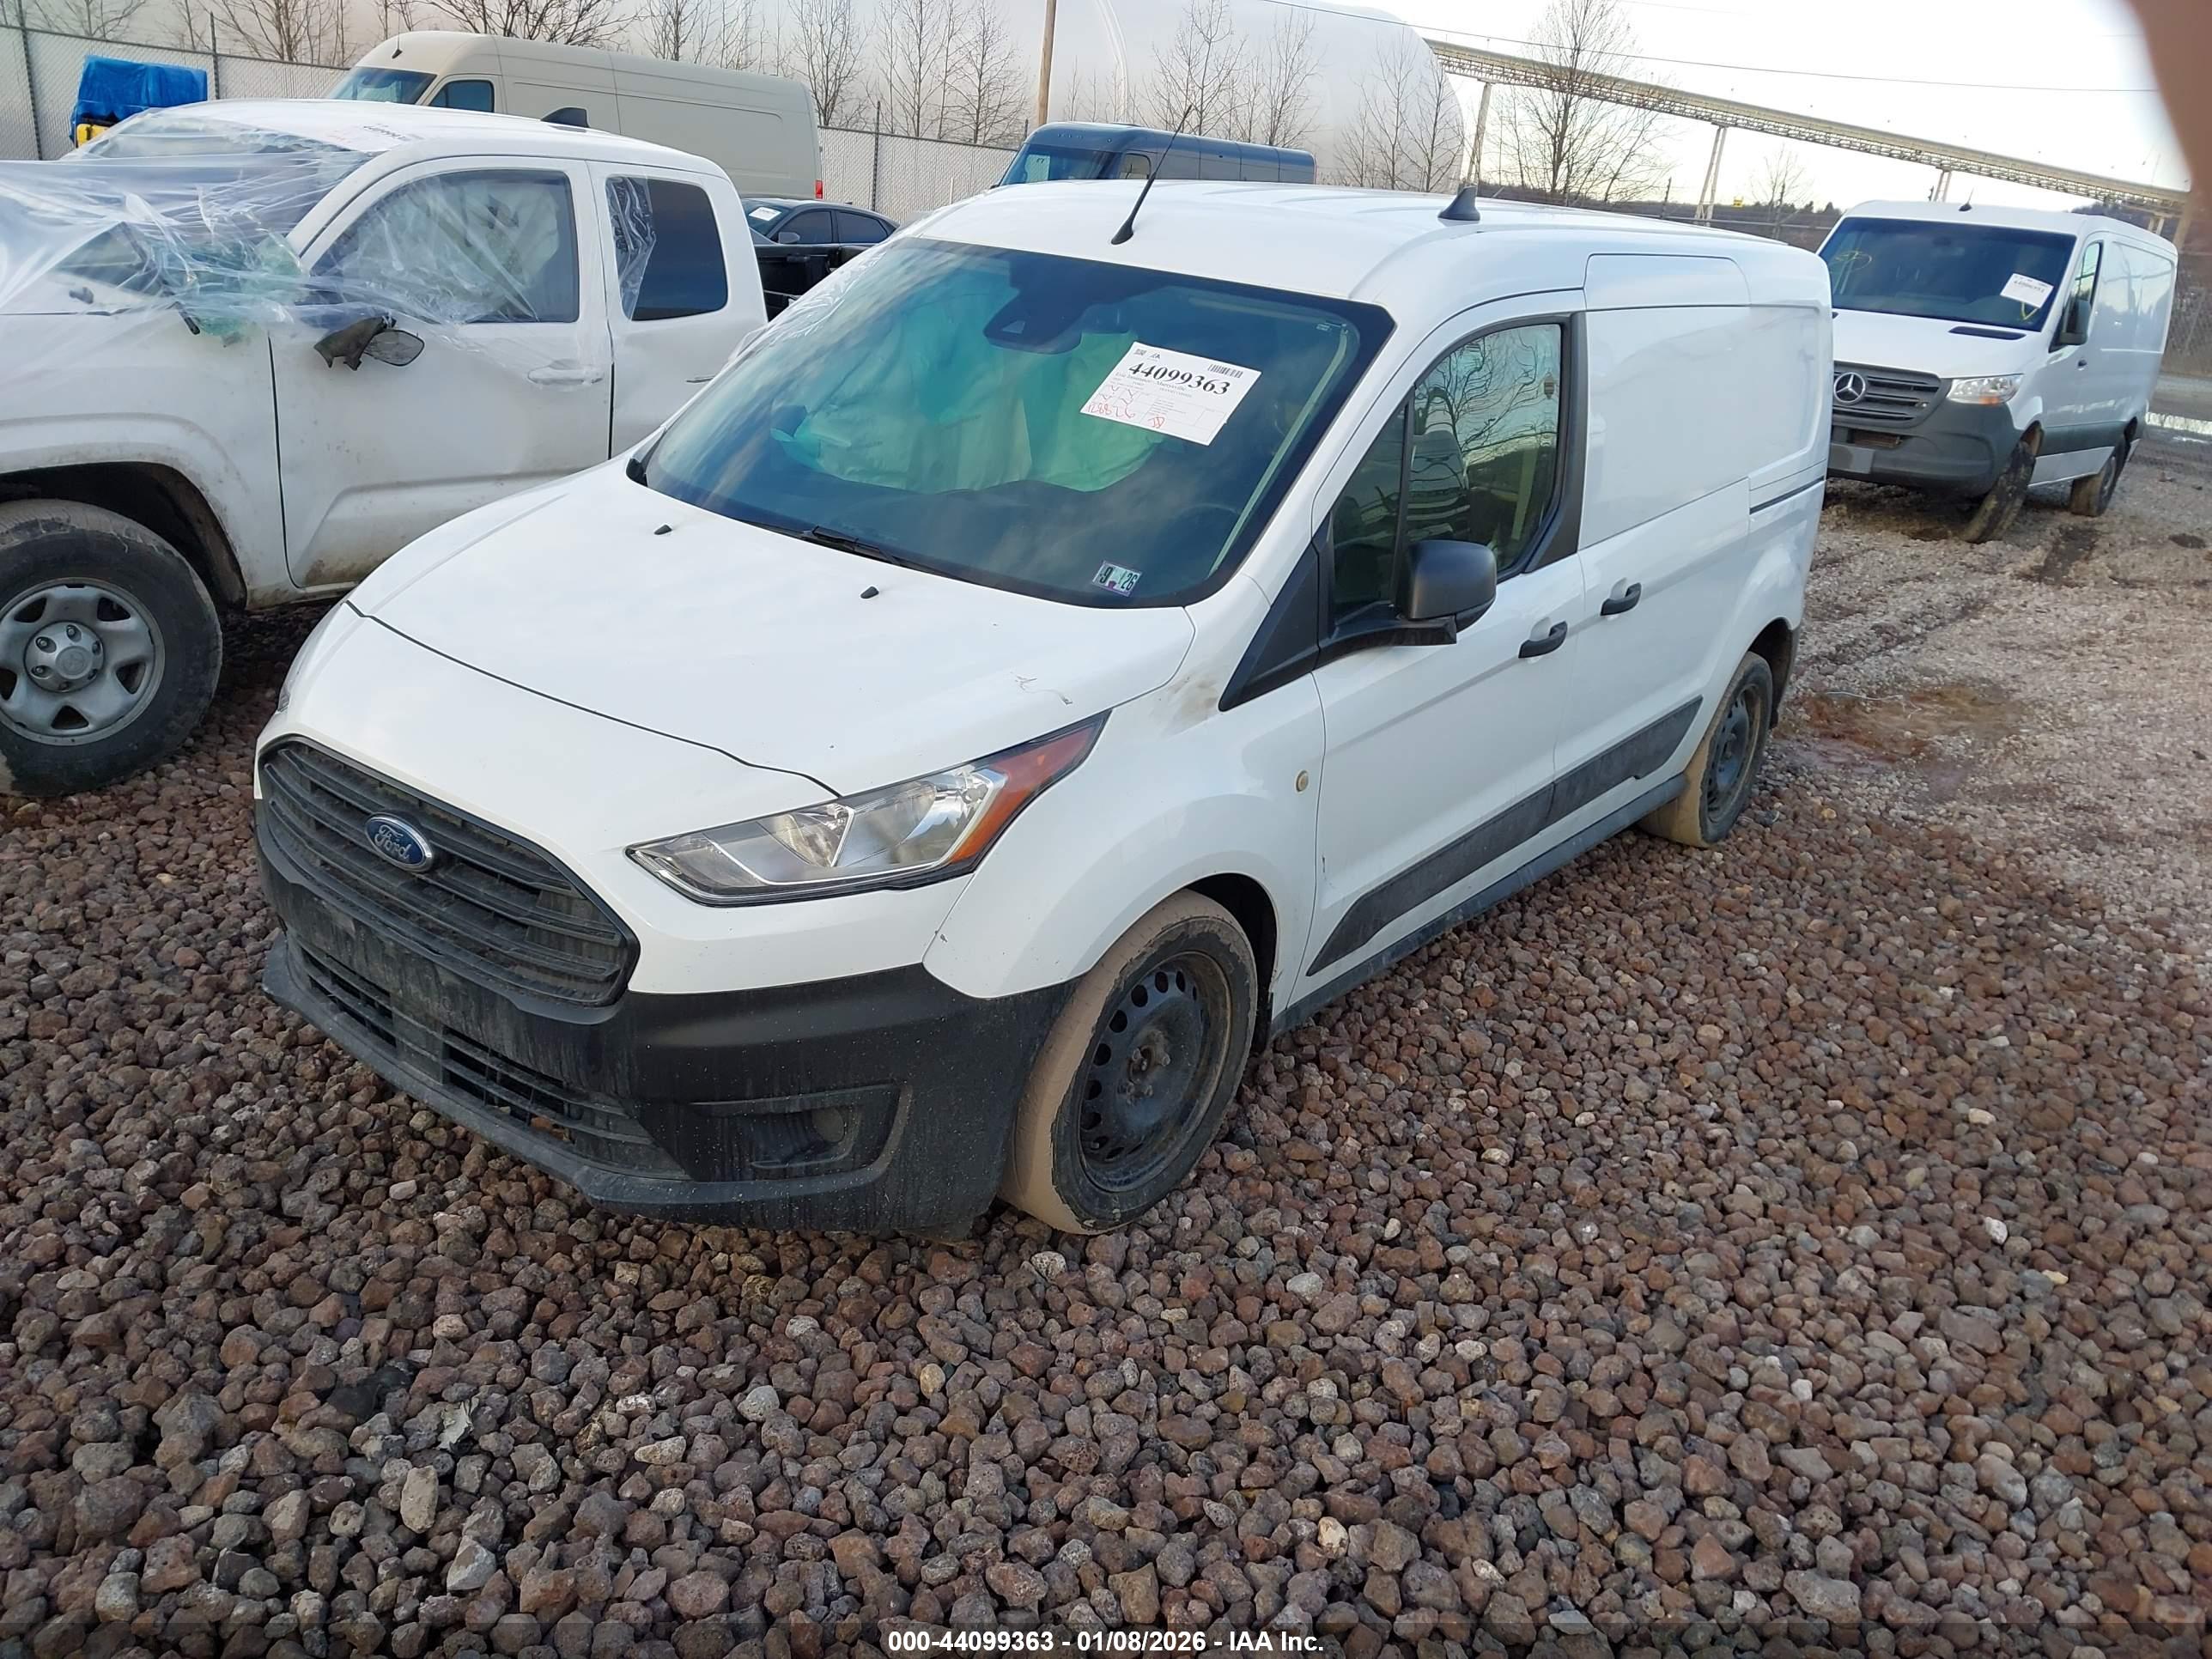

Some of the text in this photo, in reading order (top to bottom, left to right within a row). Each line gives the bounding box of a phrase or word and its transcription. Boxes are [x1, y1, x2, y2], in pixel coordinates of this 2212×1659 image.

[1128, 362, 1231, 395] 44099363
[1120, 573, 1139, 591] 26
[374, 824, 412, 860] Ford
